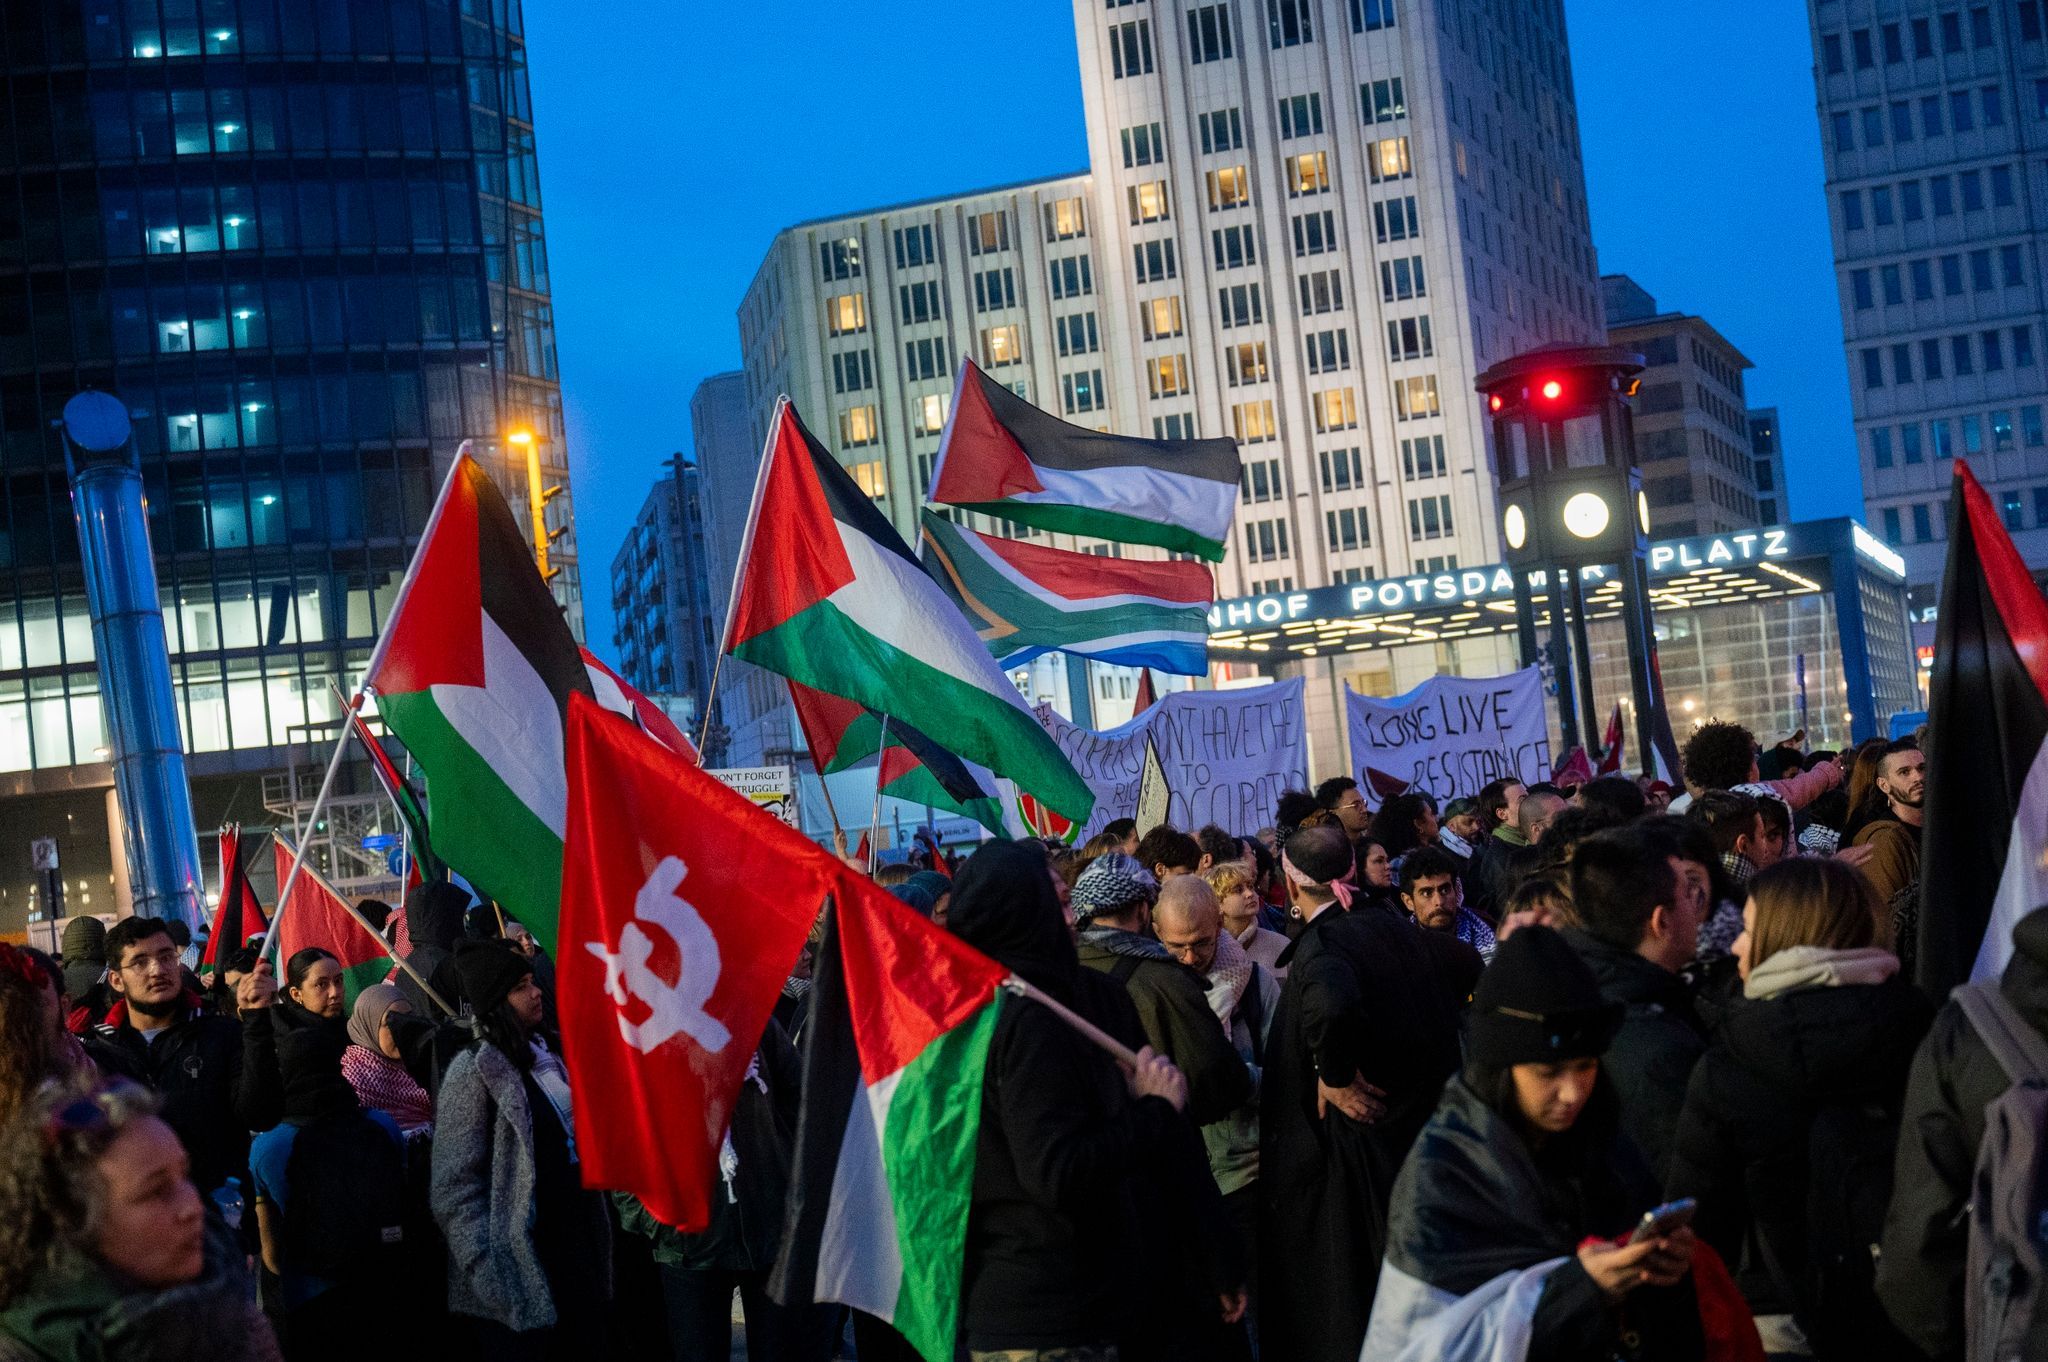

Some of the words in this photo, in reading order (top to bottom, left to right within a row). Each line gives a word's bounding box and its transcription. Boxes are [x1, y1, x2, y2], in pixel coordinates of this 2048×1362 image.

[1207, 594, 1309, 628] NHOF
[1352, 564, 1605, 610] POTSDAMR
[1652, 529, 1788, 571] PLATZ
[1201, 705, 1256, 761] HAVE
[1254, 698, 1297, 753] THE
[1364, 705, 1436, 748] LONG
[1440, 690, 1513, 736] LIVE
[744, 770, 784, 781] FORGET
[1180, 763, 1212, 785] TO
[1411, 740, 1549, 801] RESISTANCE
